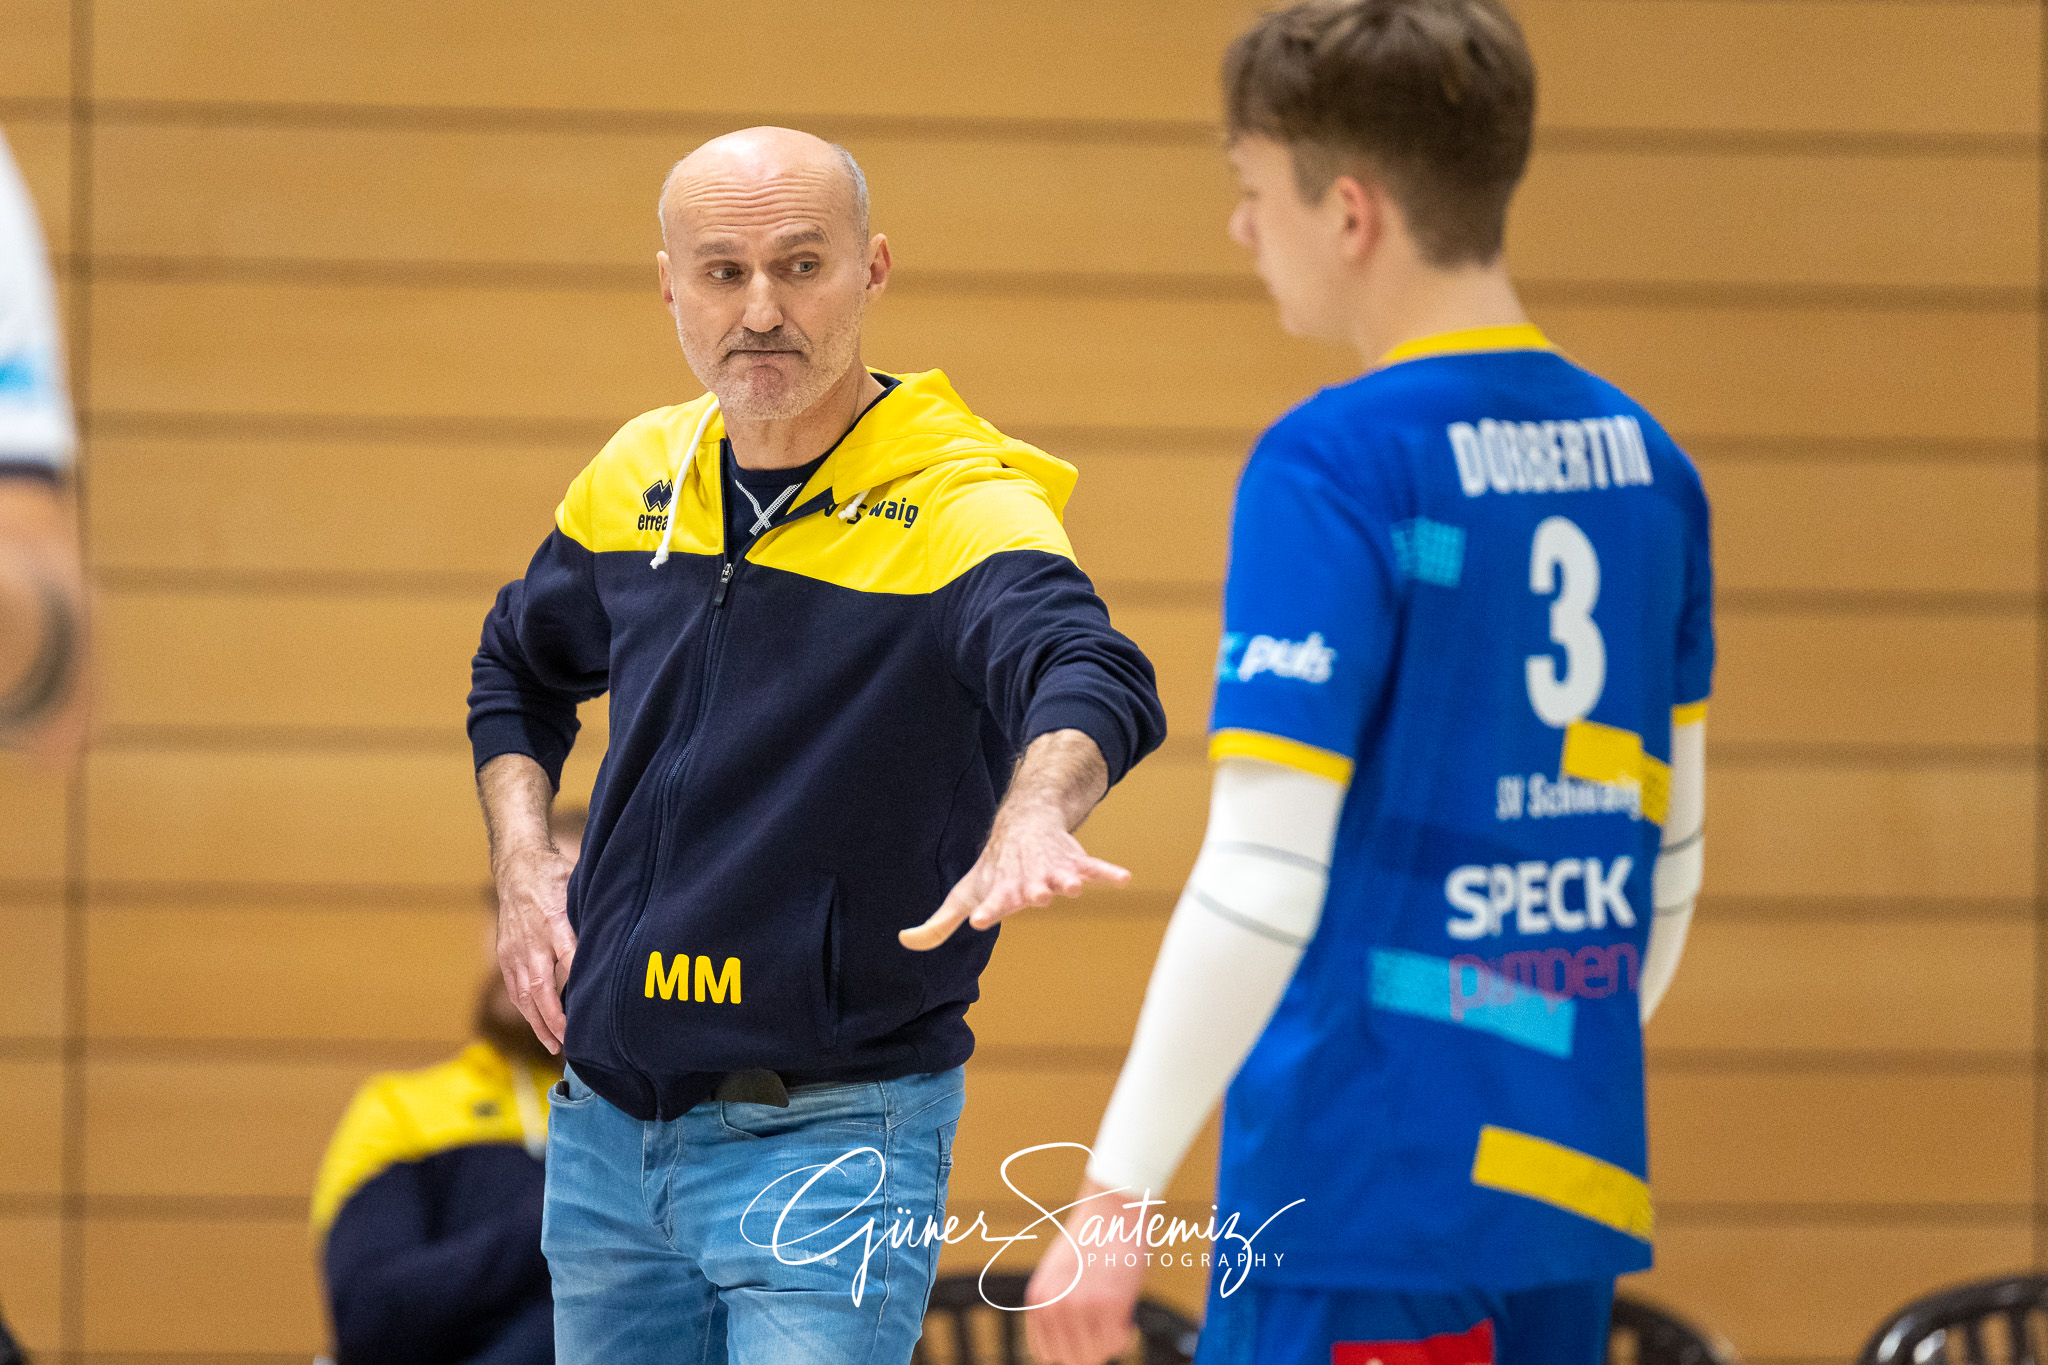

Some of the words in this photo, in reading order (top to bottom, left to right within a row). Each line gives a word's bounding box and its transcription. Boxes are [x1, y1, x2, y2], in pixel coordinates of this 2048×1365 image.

[1525, 515, 1606, 727] 3
[1445, 855, 1636, 940] SPECK
[644, 951, 742, 1004] MM
[1450, 943, 1639, 1022] pumpen
